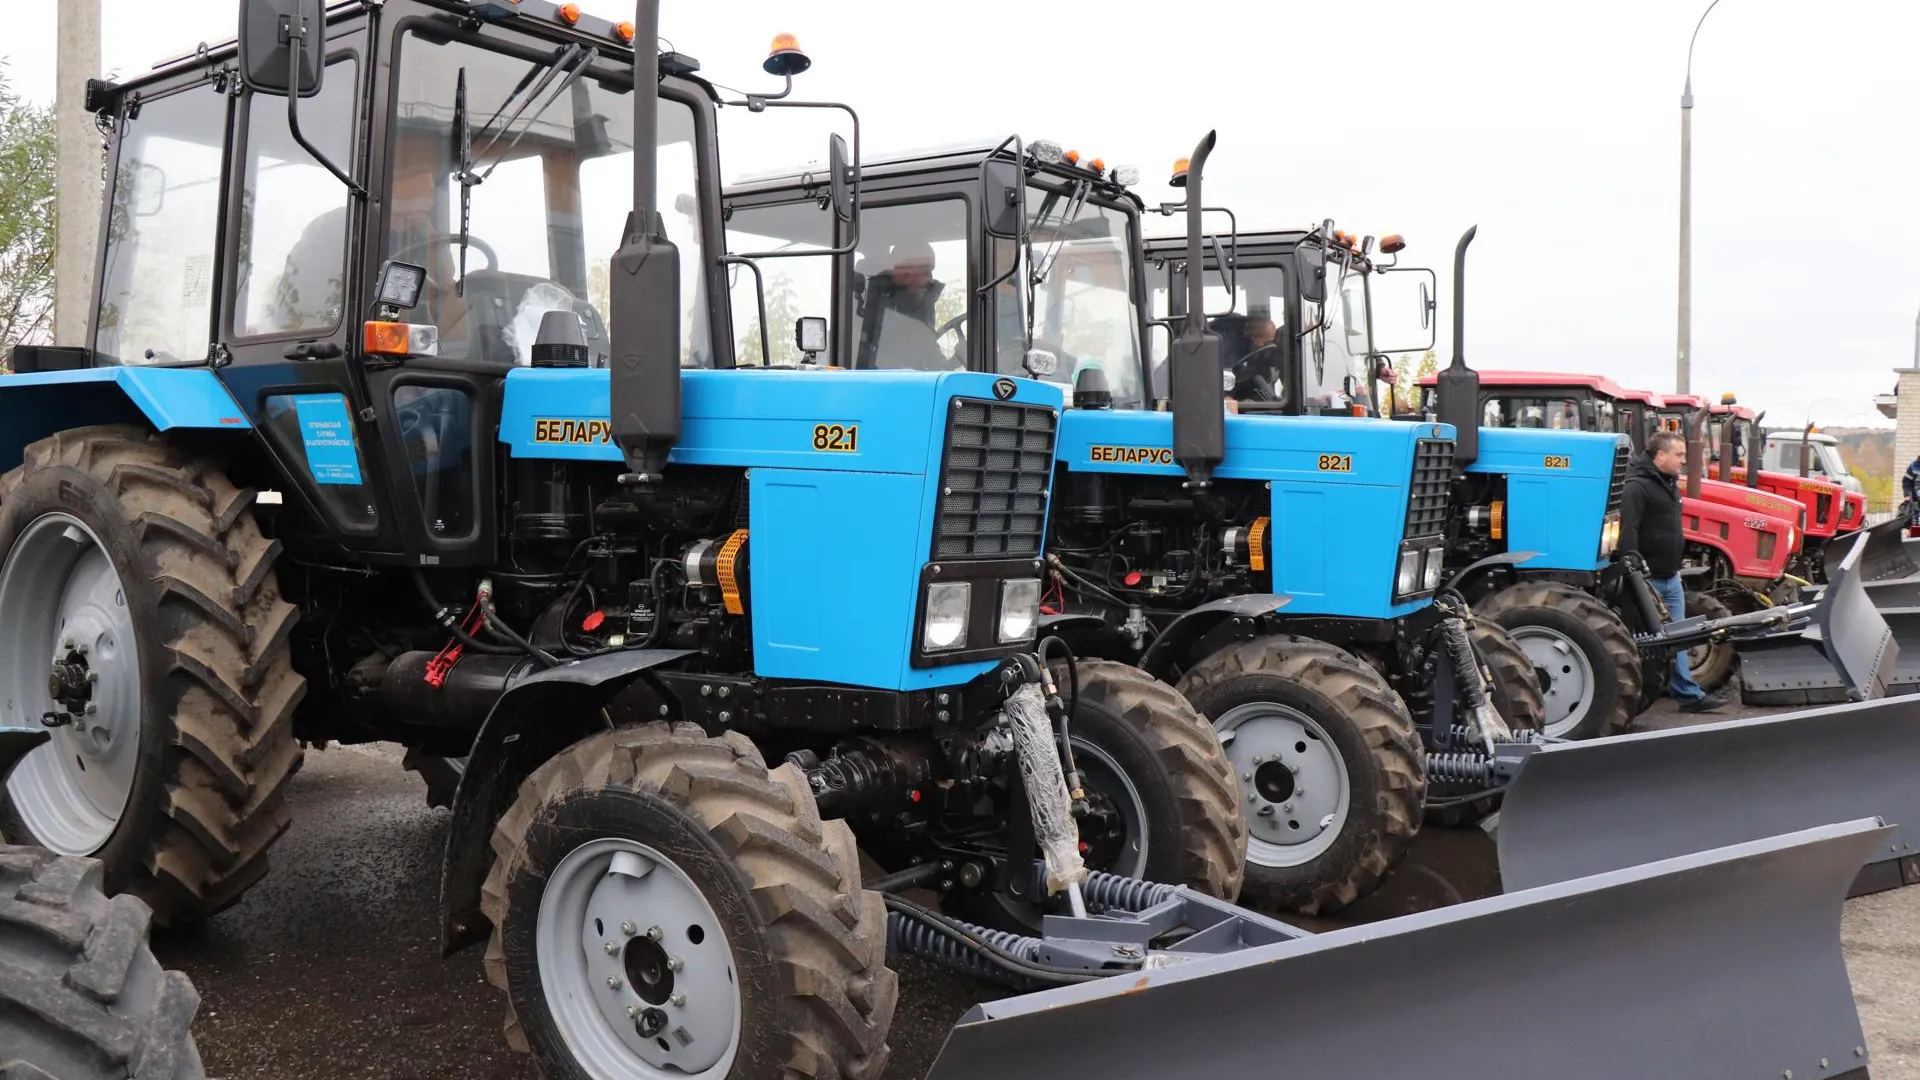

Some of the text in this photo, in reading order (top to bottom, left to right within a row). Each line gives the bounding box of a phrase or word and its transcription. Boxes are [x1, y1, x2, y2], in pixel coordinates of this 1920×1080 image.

[535, 419, 612, 444] БЕЛАРУ
[813, 423, 858, 452] 82.1
[1090, 445, 1174, 465] БЕЛАРУС
[1318, 453, 1352, 472] 82.1
[1543, 455, 1570, 469] 82.1
